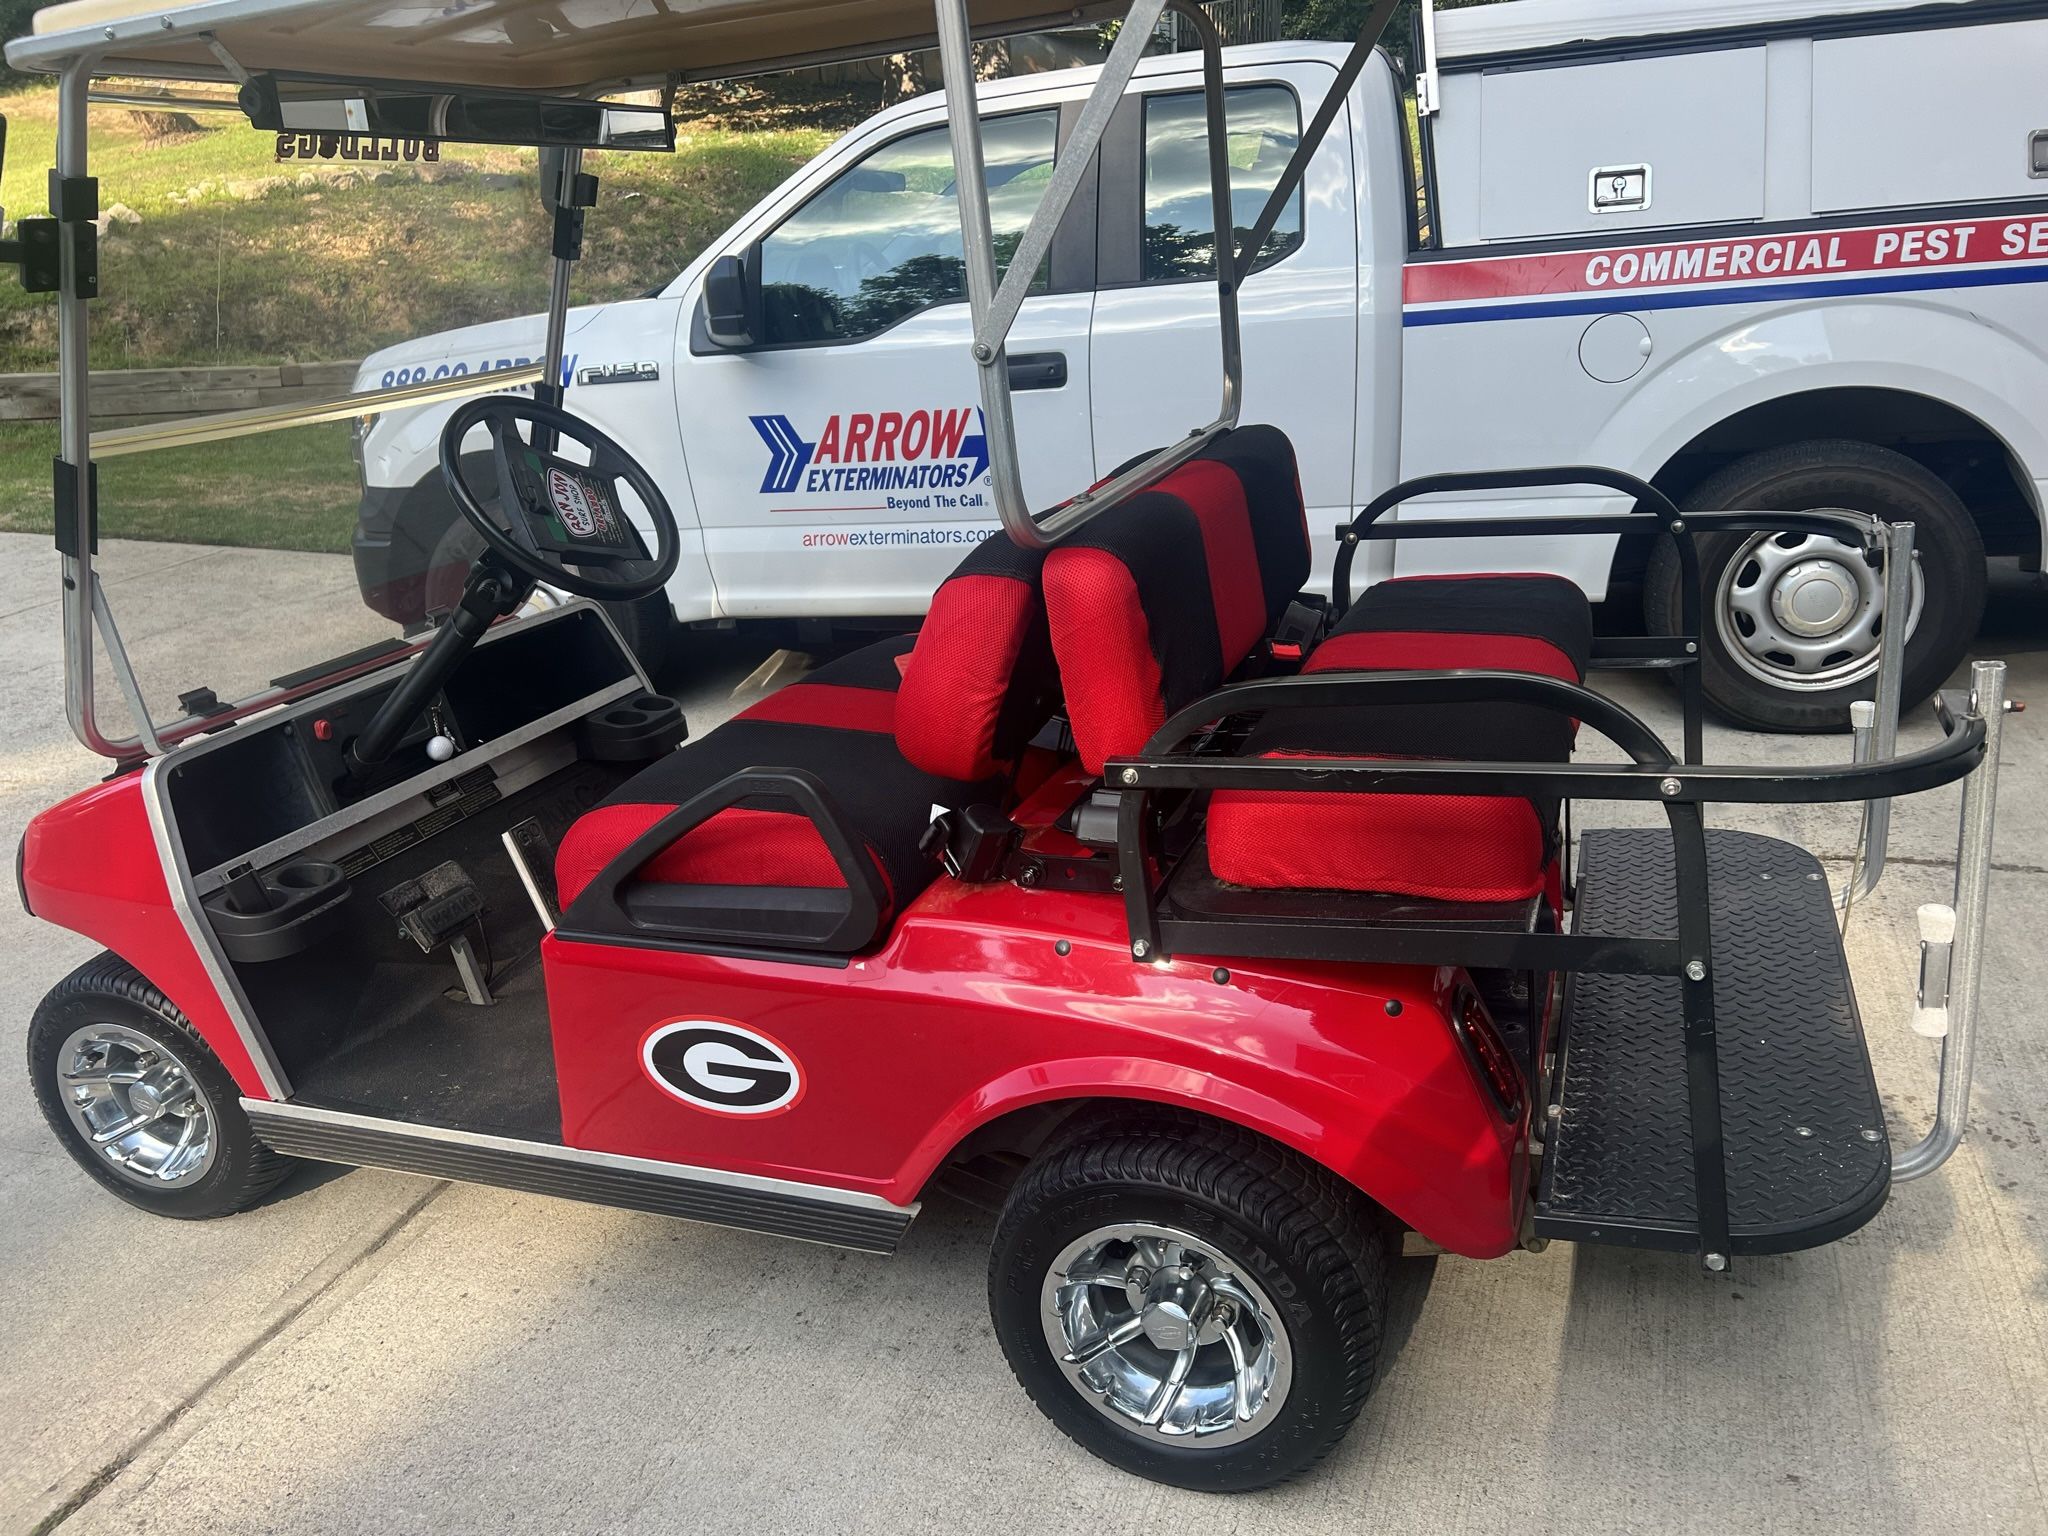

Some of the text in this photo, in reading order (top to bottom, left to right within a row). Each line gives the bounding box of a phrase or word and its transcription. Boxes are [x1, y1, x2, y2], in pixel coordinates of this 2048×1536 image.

[1585, 237, 1847, 286] COMMERCIAL
[1873, 226, 1976, 264] PEST
[813, 407, 972, 465] ARROW
[553, 473, 586, 531] RON JON
[568, 484, 590, 526] SURF SHOP
[806, 463, 969, 493] EXTERMINATORS
[887, 494, 983, 512] Beyond The Call
[651, 1028, 792, 1106] G
[1178, 1203, 1313, 1328] KENDA
